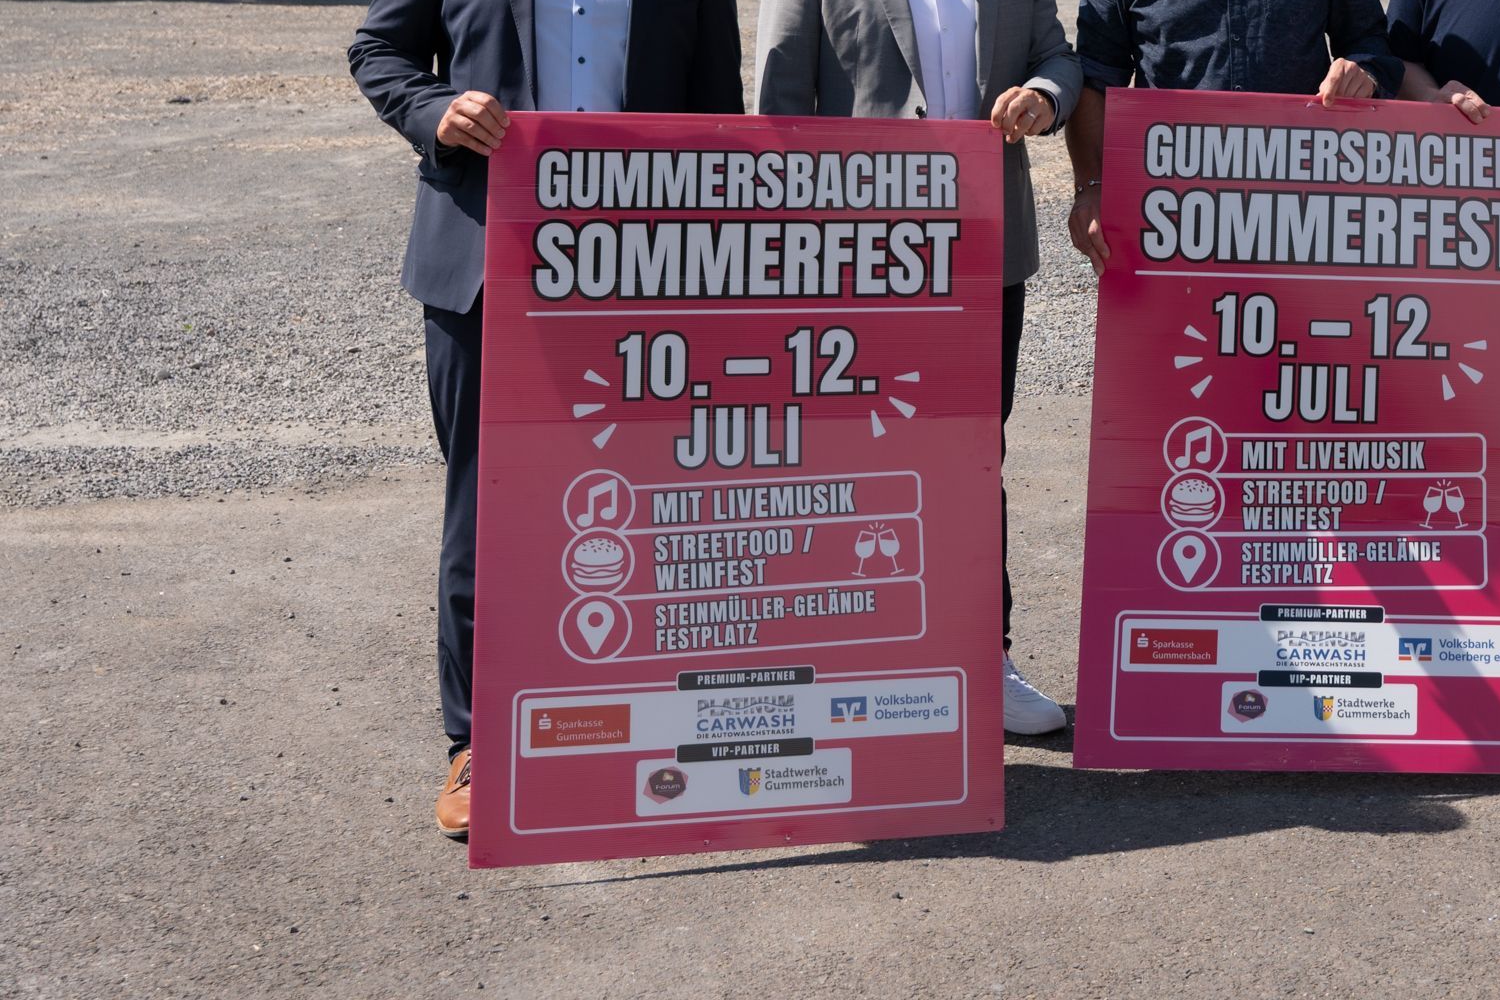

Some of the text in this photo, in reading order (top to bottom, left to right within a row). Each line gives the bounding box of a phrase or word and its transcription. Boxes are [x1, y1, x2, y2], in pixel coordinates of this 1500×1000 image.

[537, 148, 958, 209] GUMMERSBACHER
[533, 220, 960, 299] SOMMERFEST
[1213, 292, 1297, 357] 10.
[1366, 294, 1450, 359] 12.
[616, 331, 711, 400] 10.
[786, 327, 879, 395] 12.
[1263, 364, 1379, 423] JULI
[674, 405, 801, 468] JULI
[1242, 441, 1426, 471] MIT LIVEMUSIK
[1242, 480, 1369, 505] STREETFOOD
[652, 482, 856, 524] MIT LIVEMUSIK
[1242, 506, 1342, 531] WEINFEST
[654, 528, 794, 562] STREETFOOD
[1242, 539, 1441, 563] STEINMÜLLER-GELÄNDE
[654, 559, 765, 592] WEINFEST
[1242, 564, 1333, 584] FESTPLATZ
[655, 590, 875, 627] STEINMÜLLER-GELÄNDE
[1278, 608, 1367, 620] PREMIUM-PARTNER
[656, 623, 758, 652] FESTPLATZ
[1152, 639, 1194, 651] Sparkasse
[1439, 638, 1495, 650] Volksbank
[1152, 650, 1211, 660] Gummersbach
[1277, 648, 1365, 660] CARWASH
[1439, 651, 1491, 664] Oberberg
[697, 670, 796, 685] PREMIUM-PARTNER
[1290, 674, 1352, 685] VIP-PARTNER
[874, 693, 934, 706] Volksbank
[1337, 698, 1395, 709] Stadtwerke
[874, 705, 949, 722] Oberberg eG
[1337, 709, 1411, 721] Gummersbach
[556, 717, 604, 730] Sparkasse
[697, 714, 795, 731] CARWASH
[556, 728, 623, 741] Gummersbach
[712, 729, 794, 738] AUTOWASCHSTRASSE
[712, 743, 780, 757] VIP-PARTNER
[765, 766, 828, 779] Stadtwerke
[765, 776, 845, 792] Gummersbach
